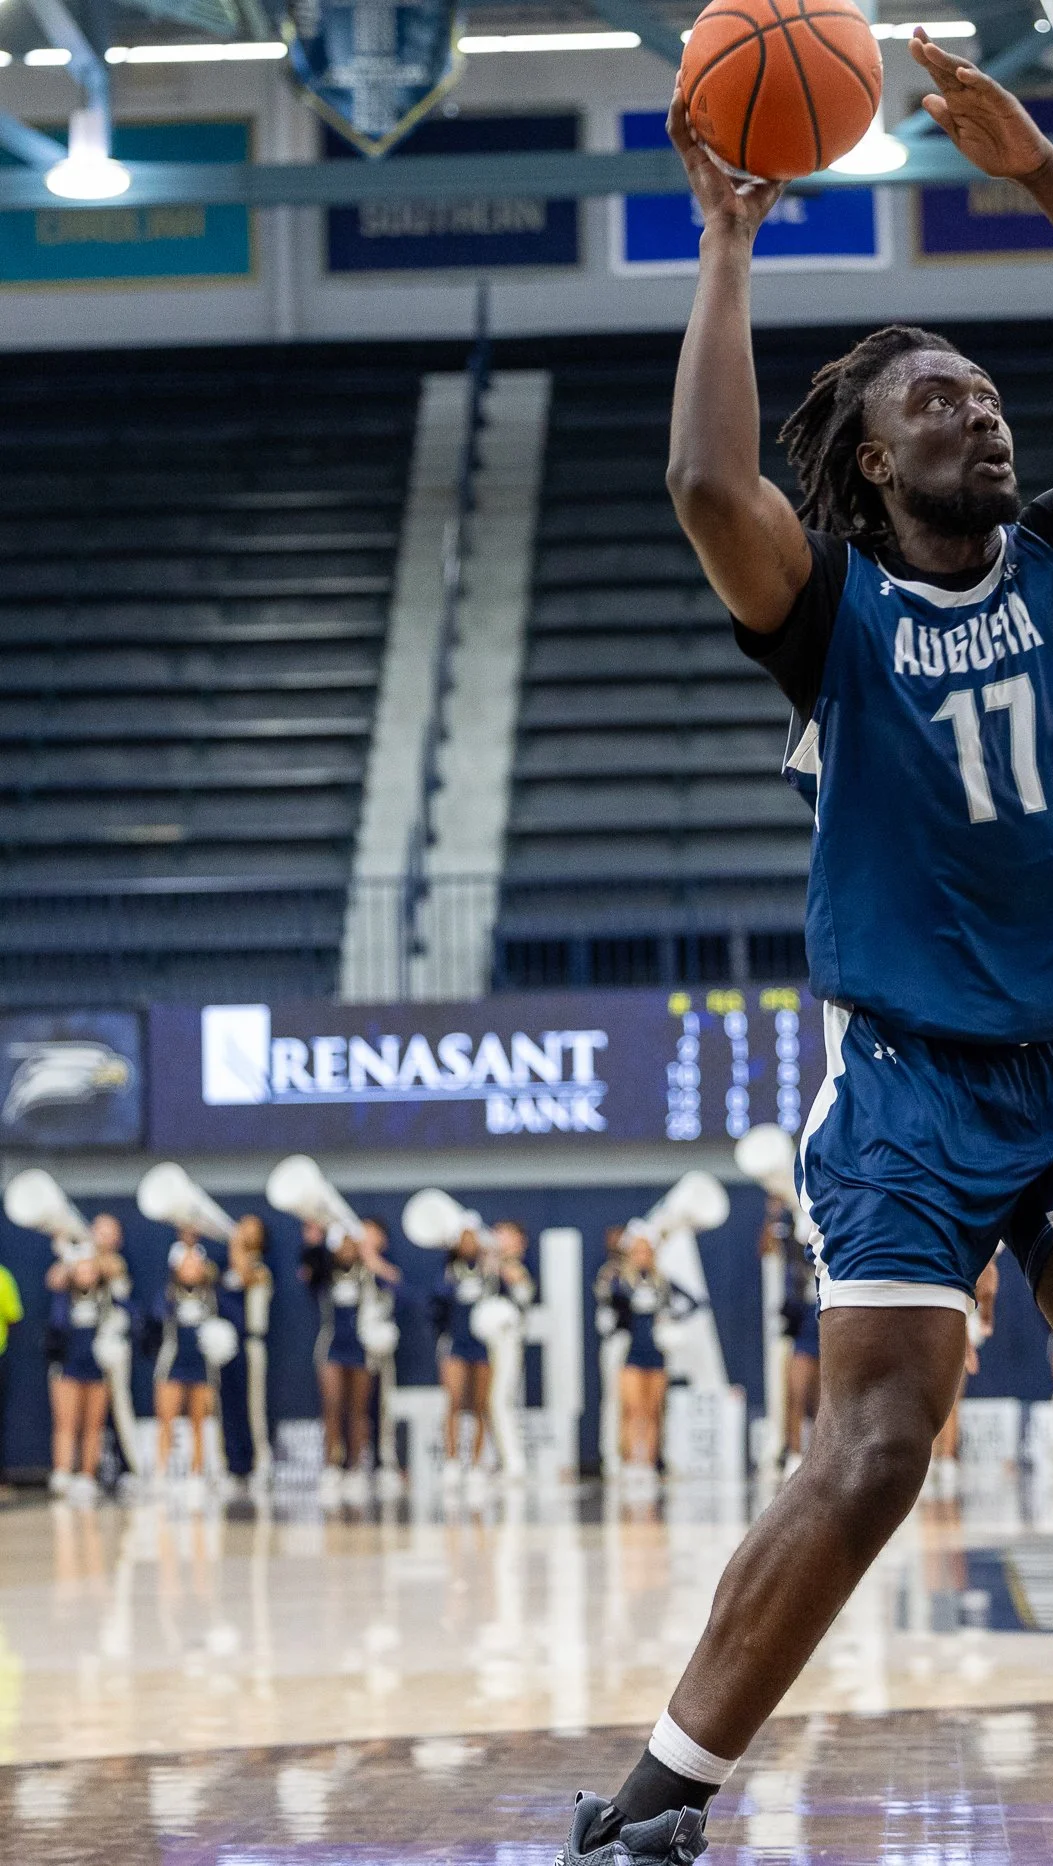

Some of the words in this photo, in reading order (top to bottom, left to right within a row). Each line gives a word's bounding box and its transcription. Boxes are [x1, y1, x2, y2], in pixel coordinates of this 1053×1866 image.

[929, 672, 1049, 825] 17
[270, 1029, 609, 1094] RENASANT
[485, 1090, 609, 1134] BANK
